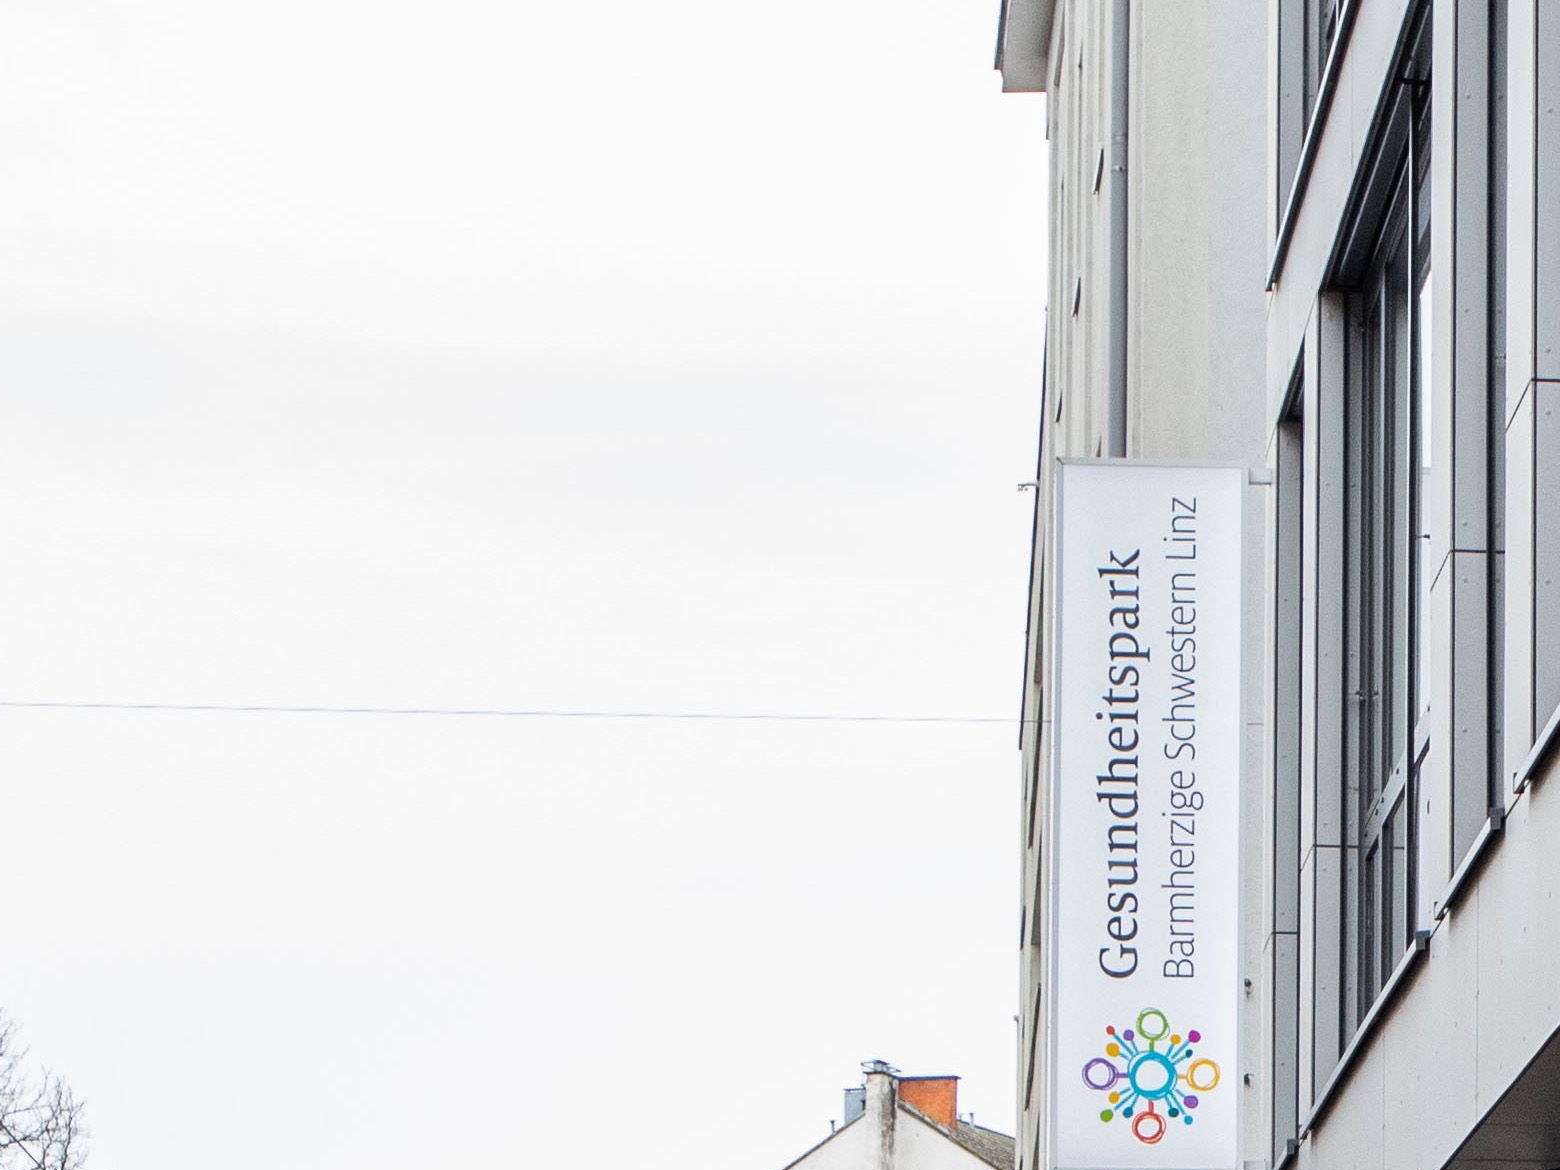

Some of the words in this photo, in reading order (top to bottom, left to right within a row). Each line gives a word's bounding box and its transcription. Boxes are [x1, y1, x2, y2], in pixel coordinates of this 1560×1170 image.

[1162, 497, 1198, 560] Linz
[1096, 548, 1151, 980] Gesundheitspark
[1162, 573, 1197, 761] Schwestern
[1161, 770, 1204, 979] Barmherzige
